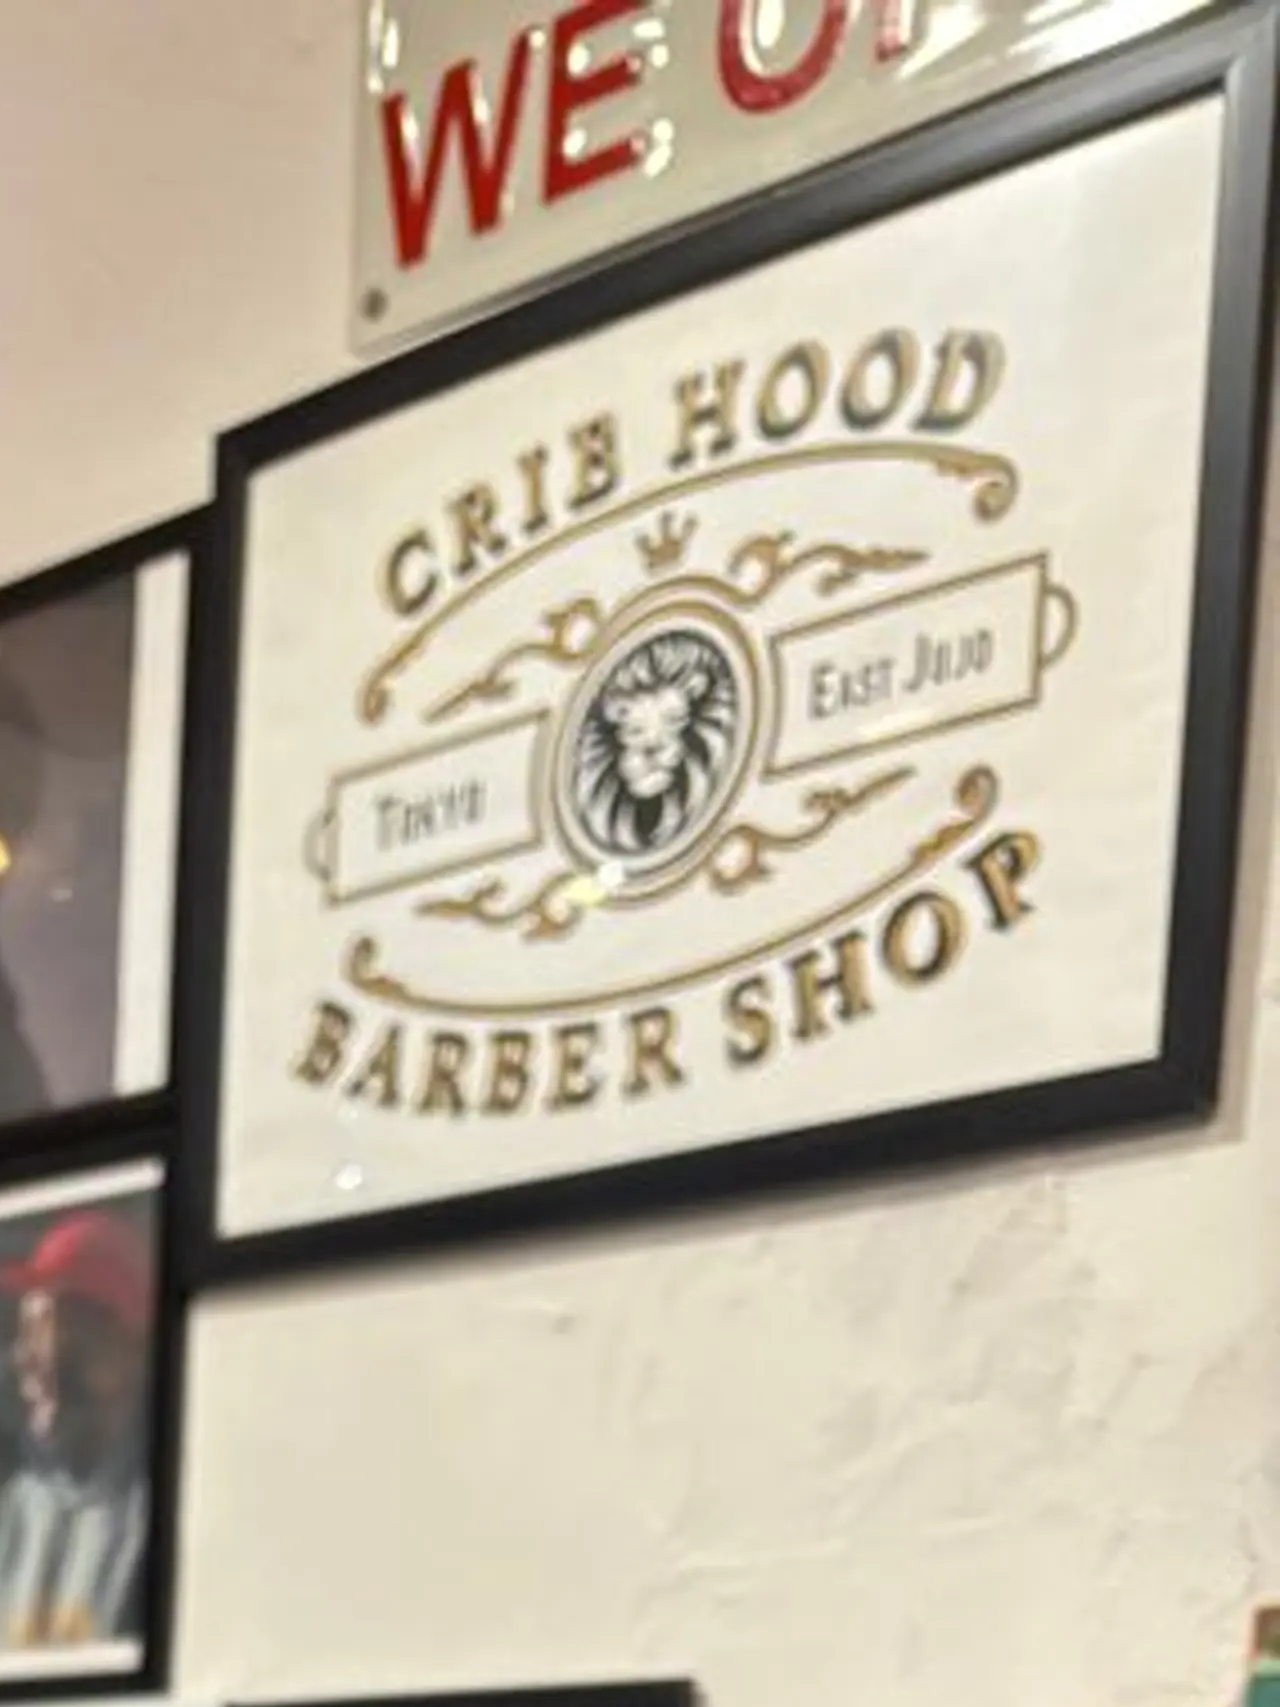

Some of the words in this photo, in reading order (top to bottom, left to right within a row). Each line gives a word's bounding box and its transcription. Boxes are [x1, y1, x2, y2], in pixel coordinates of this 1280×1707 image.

[380, 0, 646, 268] WE
[375, 415, 624, 618] CRIB
[666, 328, 1006, 474] HOOD
[289, 998, 688, 1121] BARBER
[721, 828, 1044, 1070] SHOP
